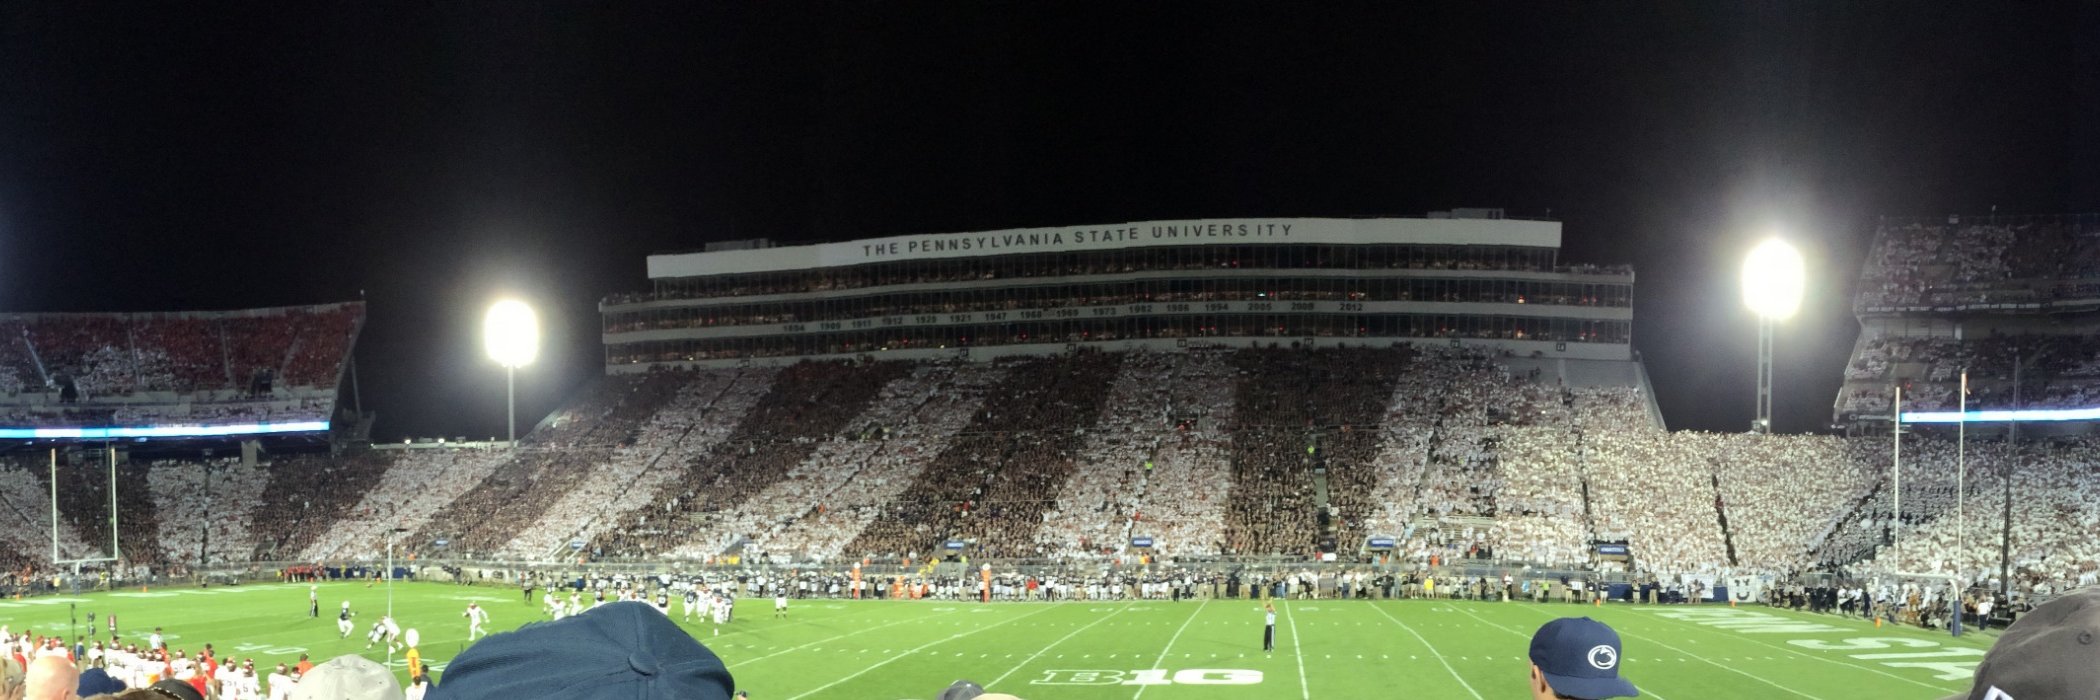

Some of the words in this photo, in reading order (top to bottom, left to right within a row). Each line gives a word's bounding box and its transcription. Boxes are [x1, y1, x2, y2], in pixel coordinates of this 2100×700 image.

[863, 242, 899, 257] THE
[908, 232, 1063, 253] PENNSYLVANIA
[1074, 227, 1138, 243] STATE
[1152, 223, 1292, 239] UNIVERSITY
[985, 312, 1006, 321] 1947
[1340, 302, 1364, 311] 2012
